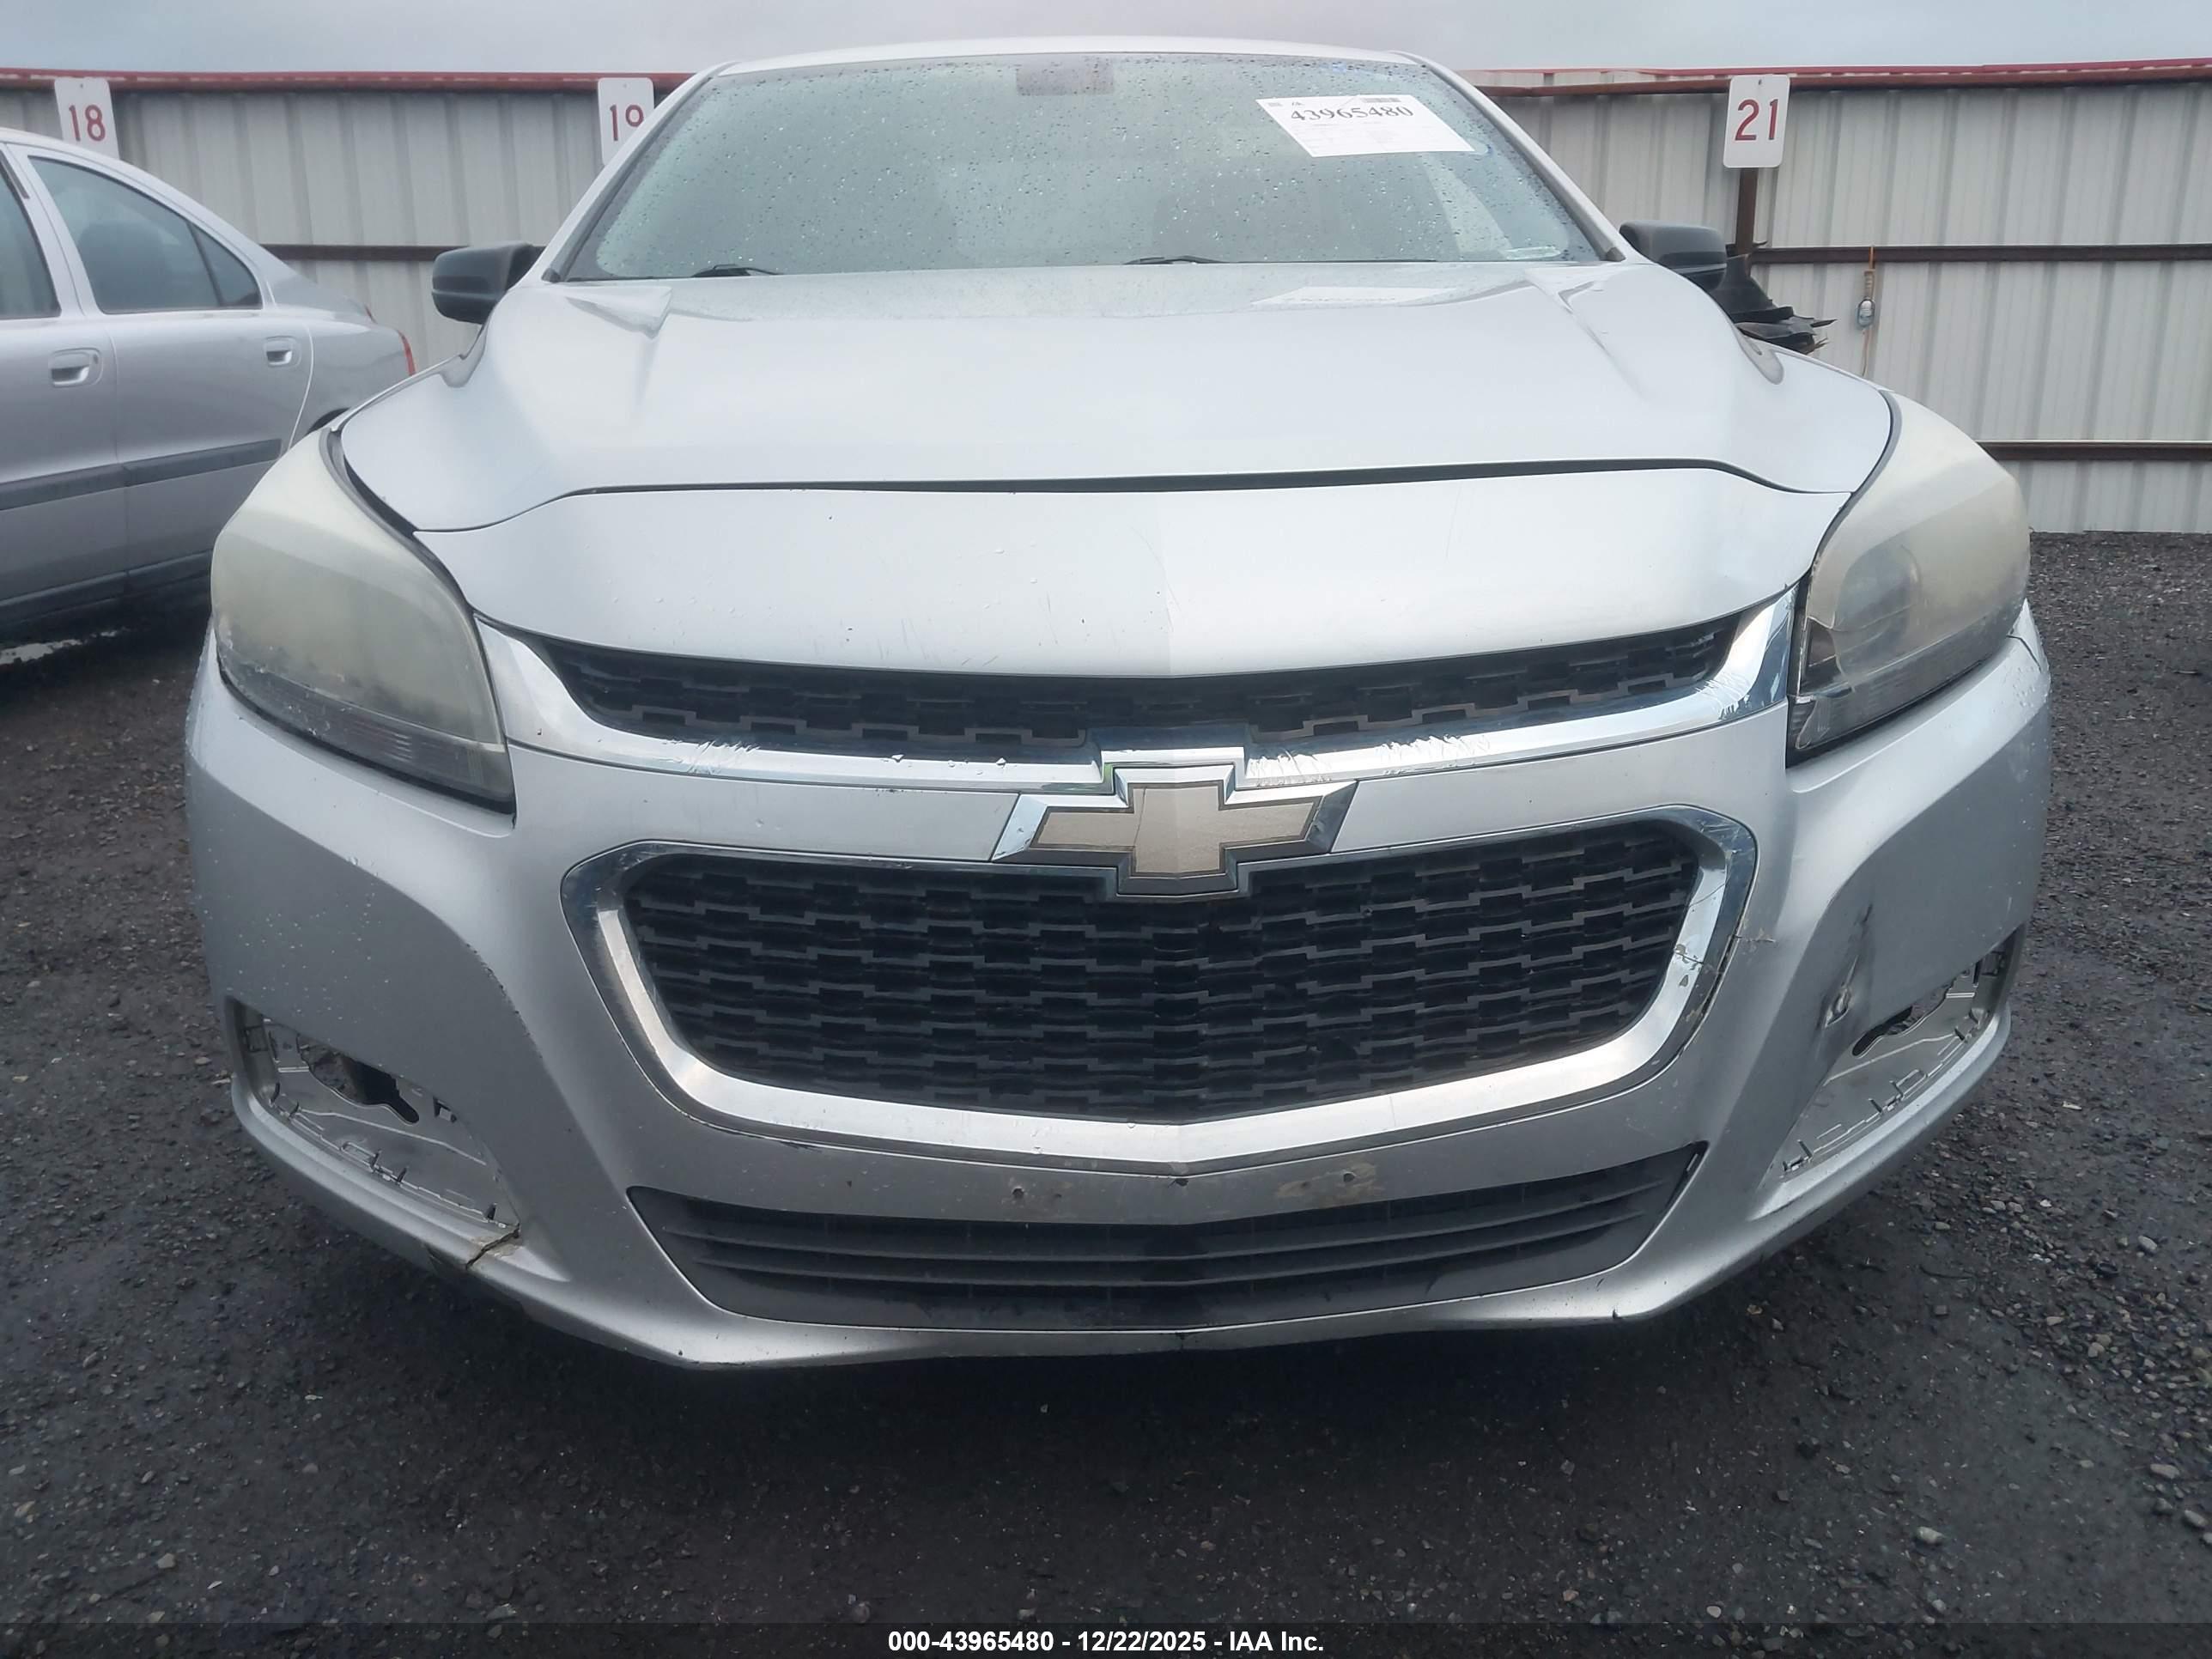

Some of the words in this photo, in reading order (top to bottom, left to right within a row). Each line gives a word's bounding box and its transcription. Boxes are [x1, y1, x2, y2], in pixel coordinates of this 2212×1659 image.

[69, 104, 106, 142] 18
[1291, 106, 1413, 121] 43965480
[1735, 99, 1778, 141] 21
